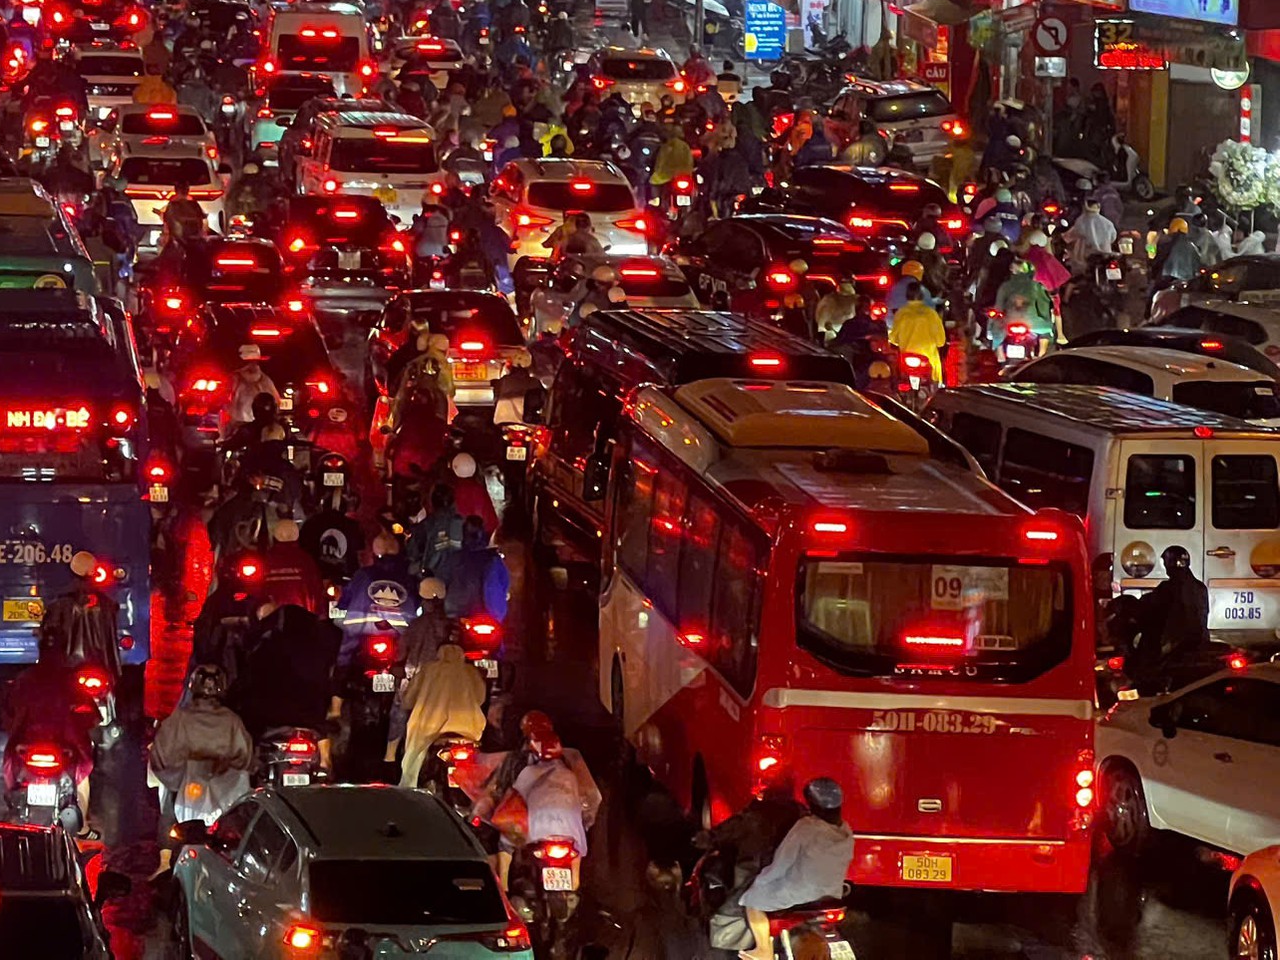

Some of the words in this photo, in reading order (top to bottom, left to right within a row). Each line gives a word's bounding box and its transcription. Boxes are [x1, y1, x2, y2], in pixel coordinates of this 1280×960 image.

[934, 576, 962, 598] 09
[1233, 591, 1254, 604] 75D
[1225, 608, 1261, 620] 003.85
[871, 711, 997, 735] 50H-083.29
[916, 857, 938, 868] 50H
